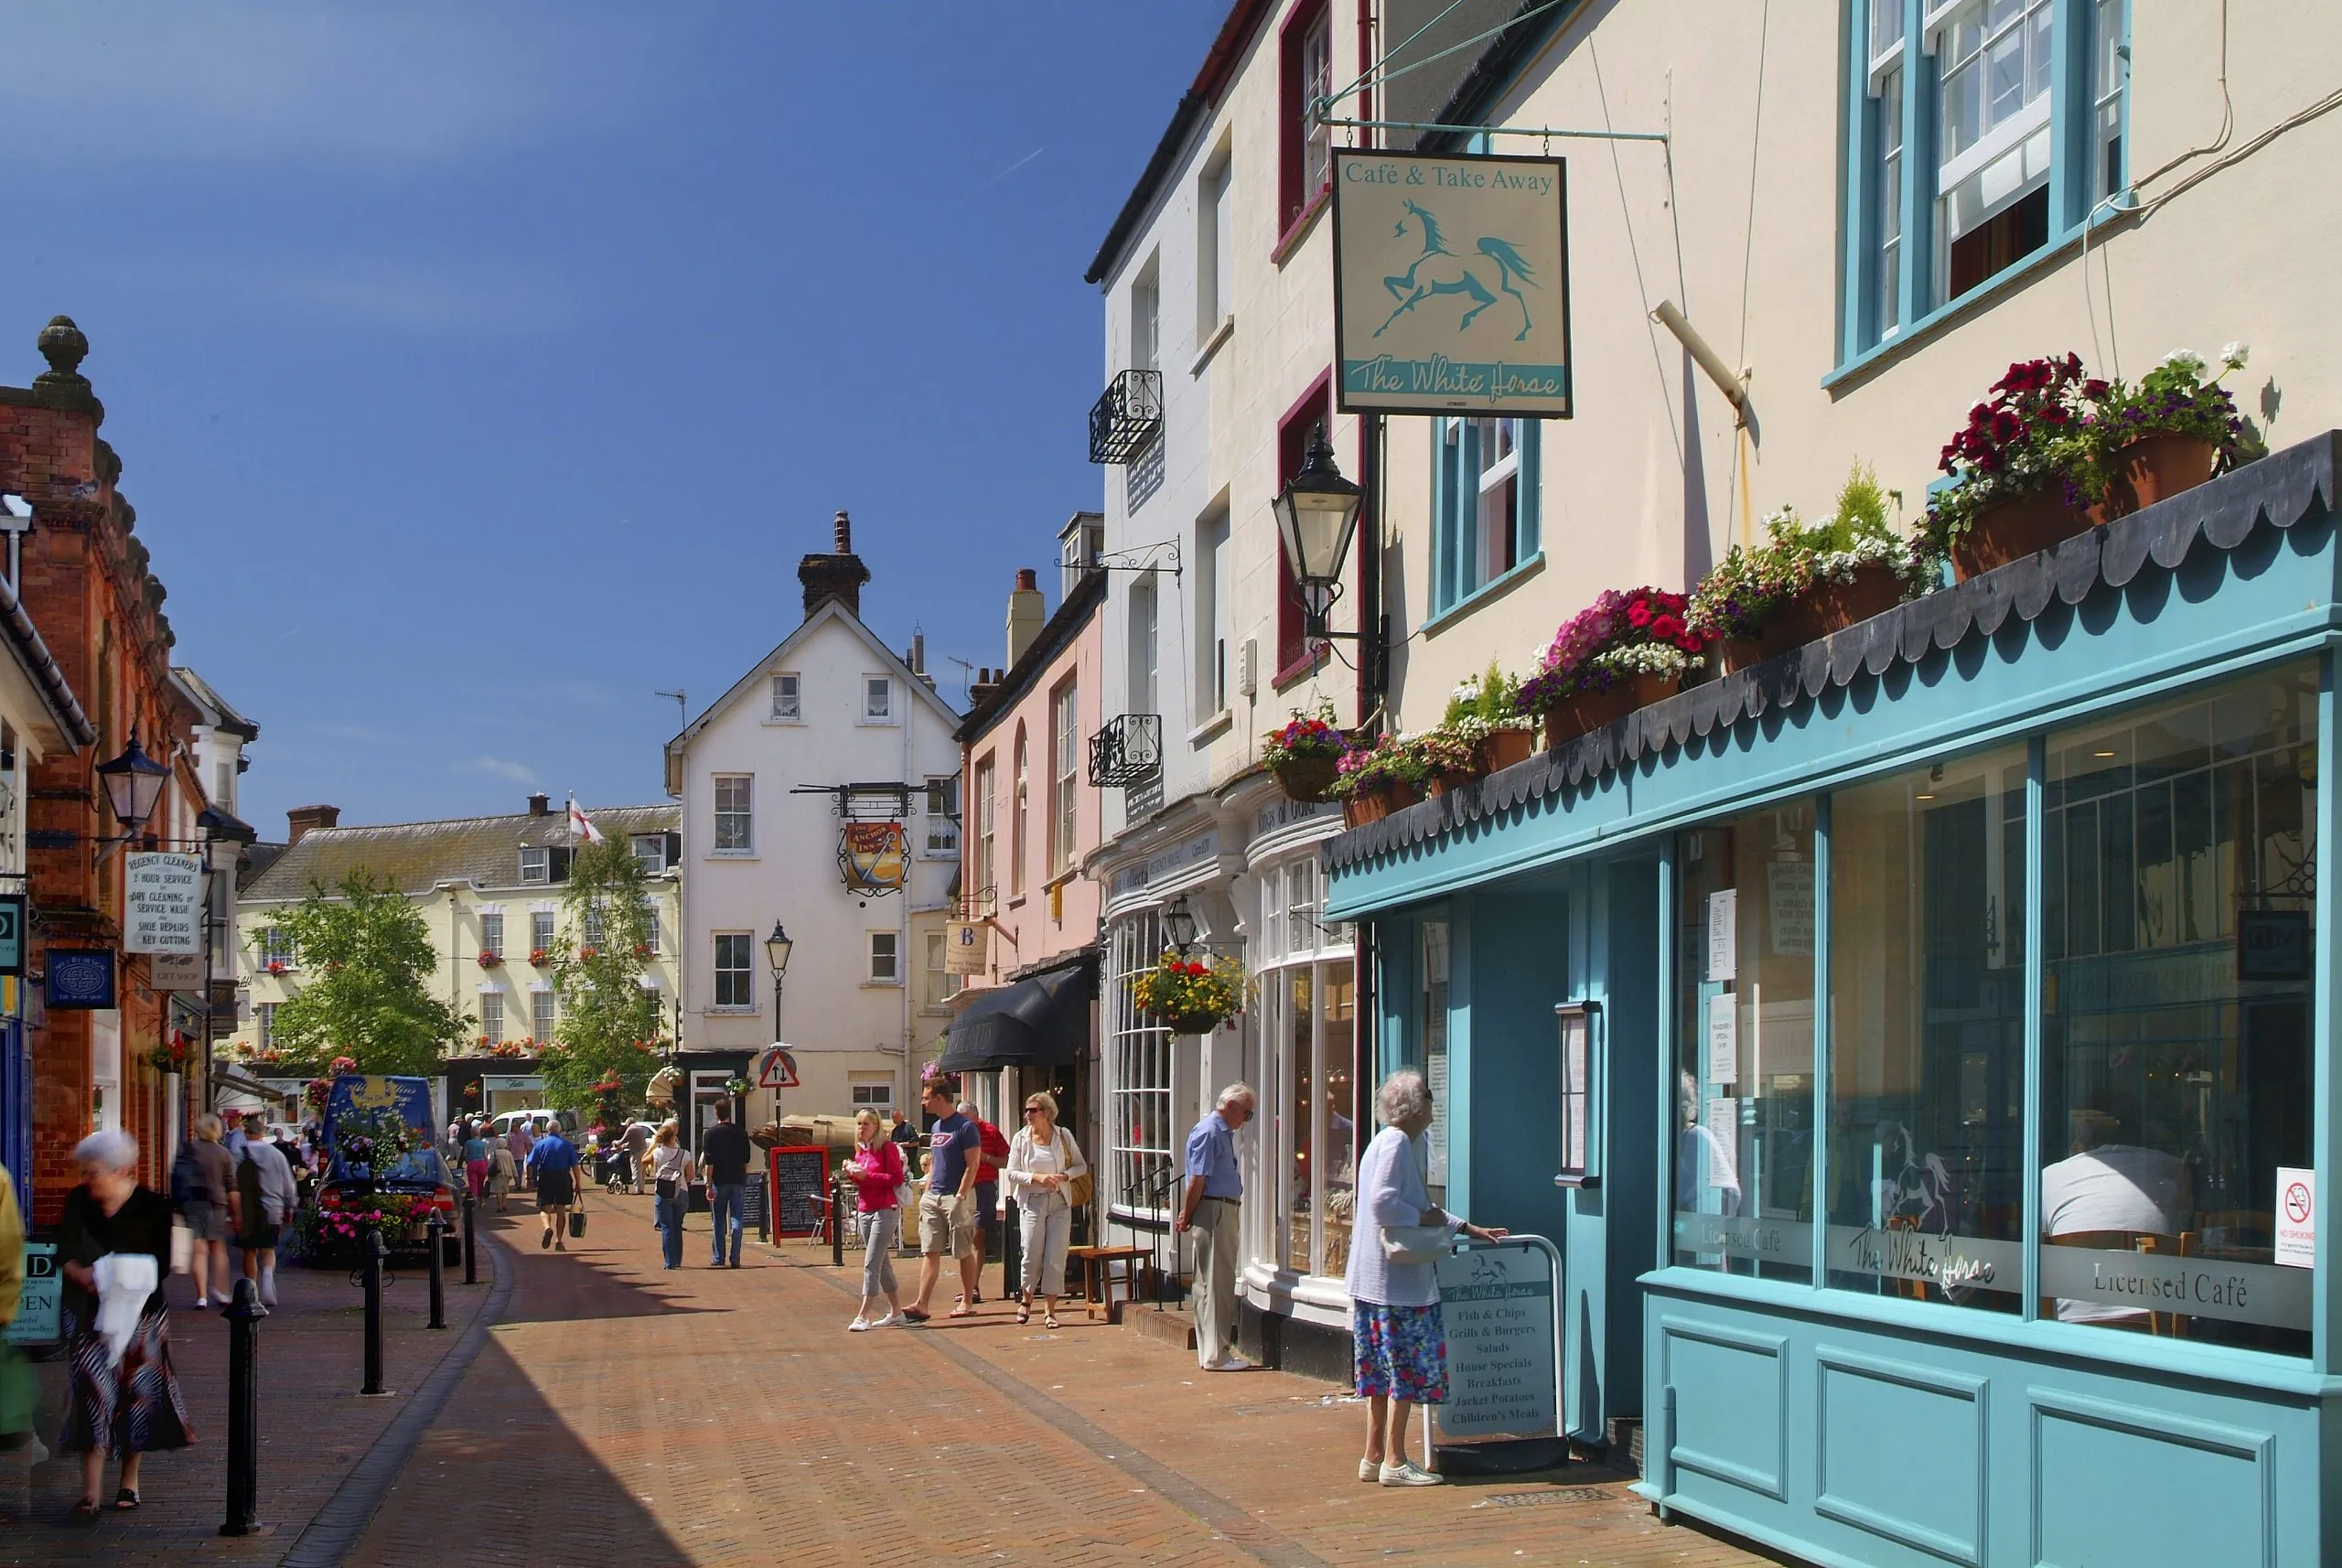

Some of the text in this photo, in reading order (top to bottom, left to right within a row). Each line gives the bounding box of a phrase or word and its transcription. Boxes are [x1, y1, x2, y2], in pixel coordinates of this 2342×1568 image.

[1346, 162, 1552, 196] Café & Take Away
[1350, 353, 1561, 403] The White Horse
[1279, 797, 1286, 824] of
[853, 826, 886, 842] ANCHOR
[860, 843, 875, 853] INN
[128, 855, 199, 873] REGENCY CLEANERS
[134, 874, 192, 885] 2 HOUR SERVICE
[1123, 869, 1149, 890] Collecta
[131, 892, 145, 902] DRY
[149, 892, 183, 903] CLEANING
[136, 904, 188, 915] SERVICE WASH
[138, 921, 188, 932] SHOE REPAIRS
[142, 935, 190, 946] KEY CUTTING
[961, 928, 974, 946] B
[157, 972, 199, 981] GIFT SHOP
[1702, 1223, 1780, 1252] Licensed Café
[2280, 1229, 2315, 1241] NO SMOKING
[1849, 1219, 1996, 1291] The White Horse
[31, 1256, 51, 1275] D
[1447, 1283, 1535, 1302] The White Horse
[2093, 1262, 2248, 1308] Licensed Café
[1457, 1307, 1526, 1322] Fish & Chips
[1449, 1325, 1536, 1339] Grills & Burgers
[1477, 1342, 1509, 1354] Salads
[1456, 1359, 1532, 1373] House Specials
[1467, 1377, 1522, 1390] Breakfasts
[1456, 1391, 1535, 1407] Jacket Potatoes
[1452, 1408, 1540, 1424] Children's Meals
